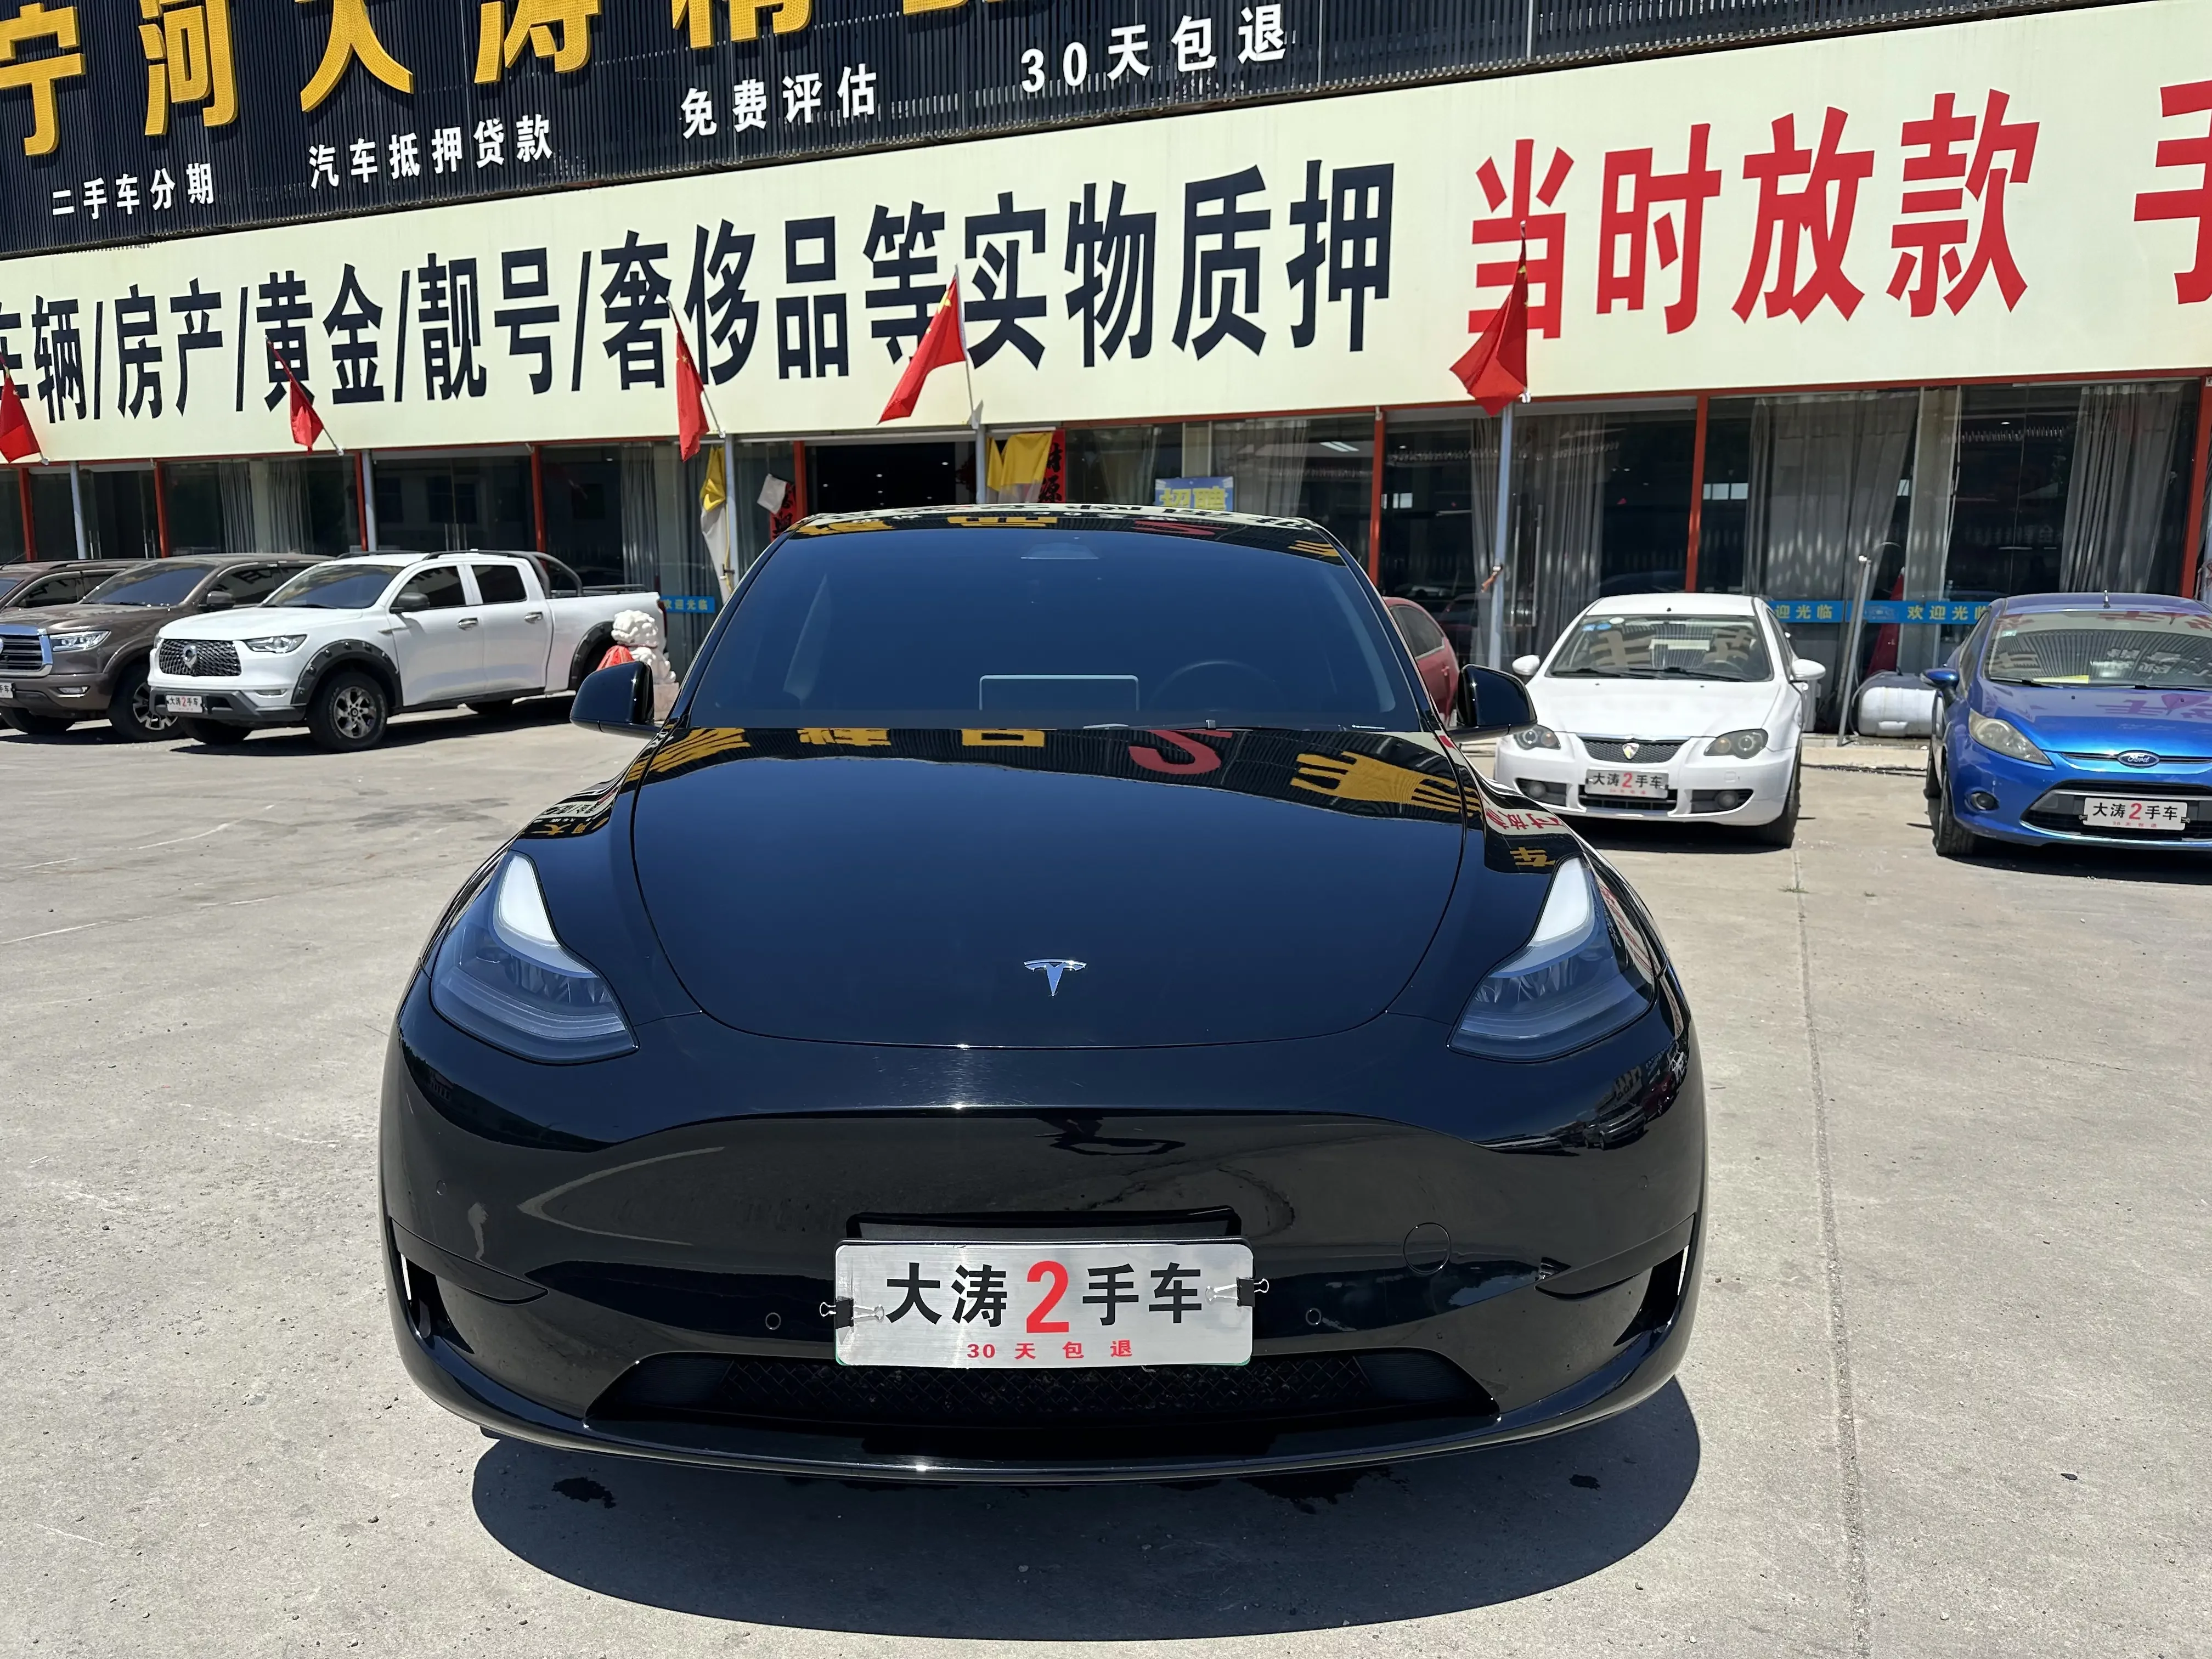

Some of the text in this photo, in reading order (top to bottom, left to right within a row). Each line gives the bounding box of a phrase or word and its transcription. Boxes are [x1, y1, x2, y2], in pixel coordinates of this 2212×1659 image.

[52, 3, 1286, 219] 二手车分期 汽车抵押贷款 免费评估 30天包退
[1468, 88, 2039, 338] 当时放款
[1593, 772, 1663, 789] 大涛2手车
[2092, 802, 2178, 820] 大涛2手车
[885, 1260, 1203, 1334] 大涛2手车
[967, 1340, 1133, 1359] 30天包退
